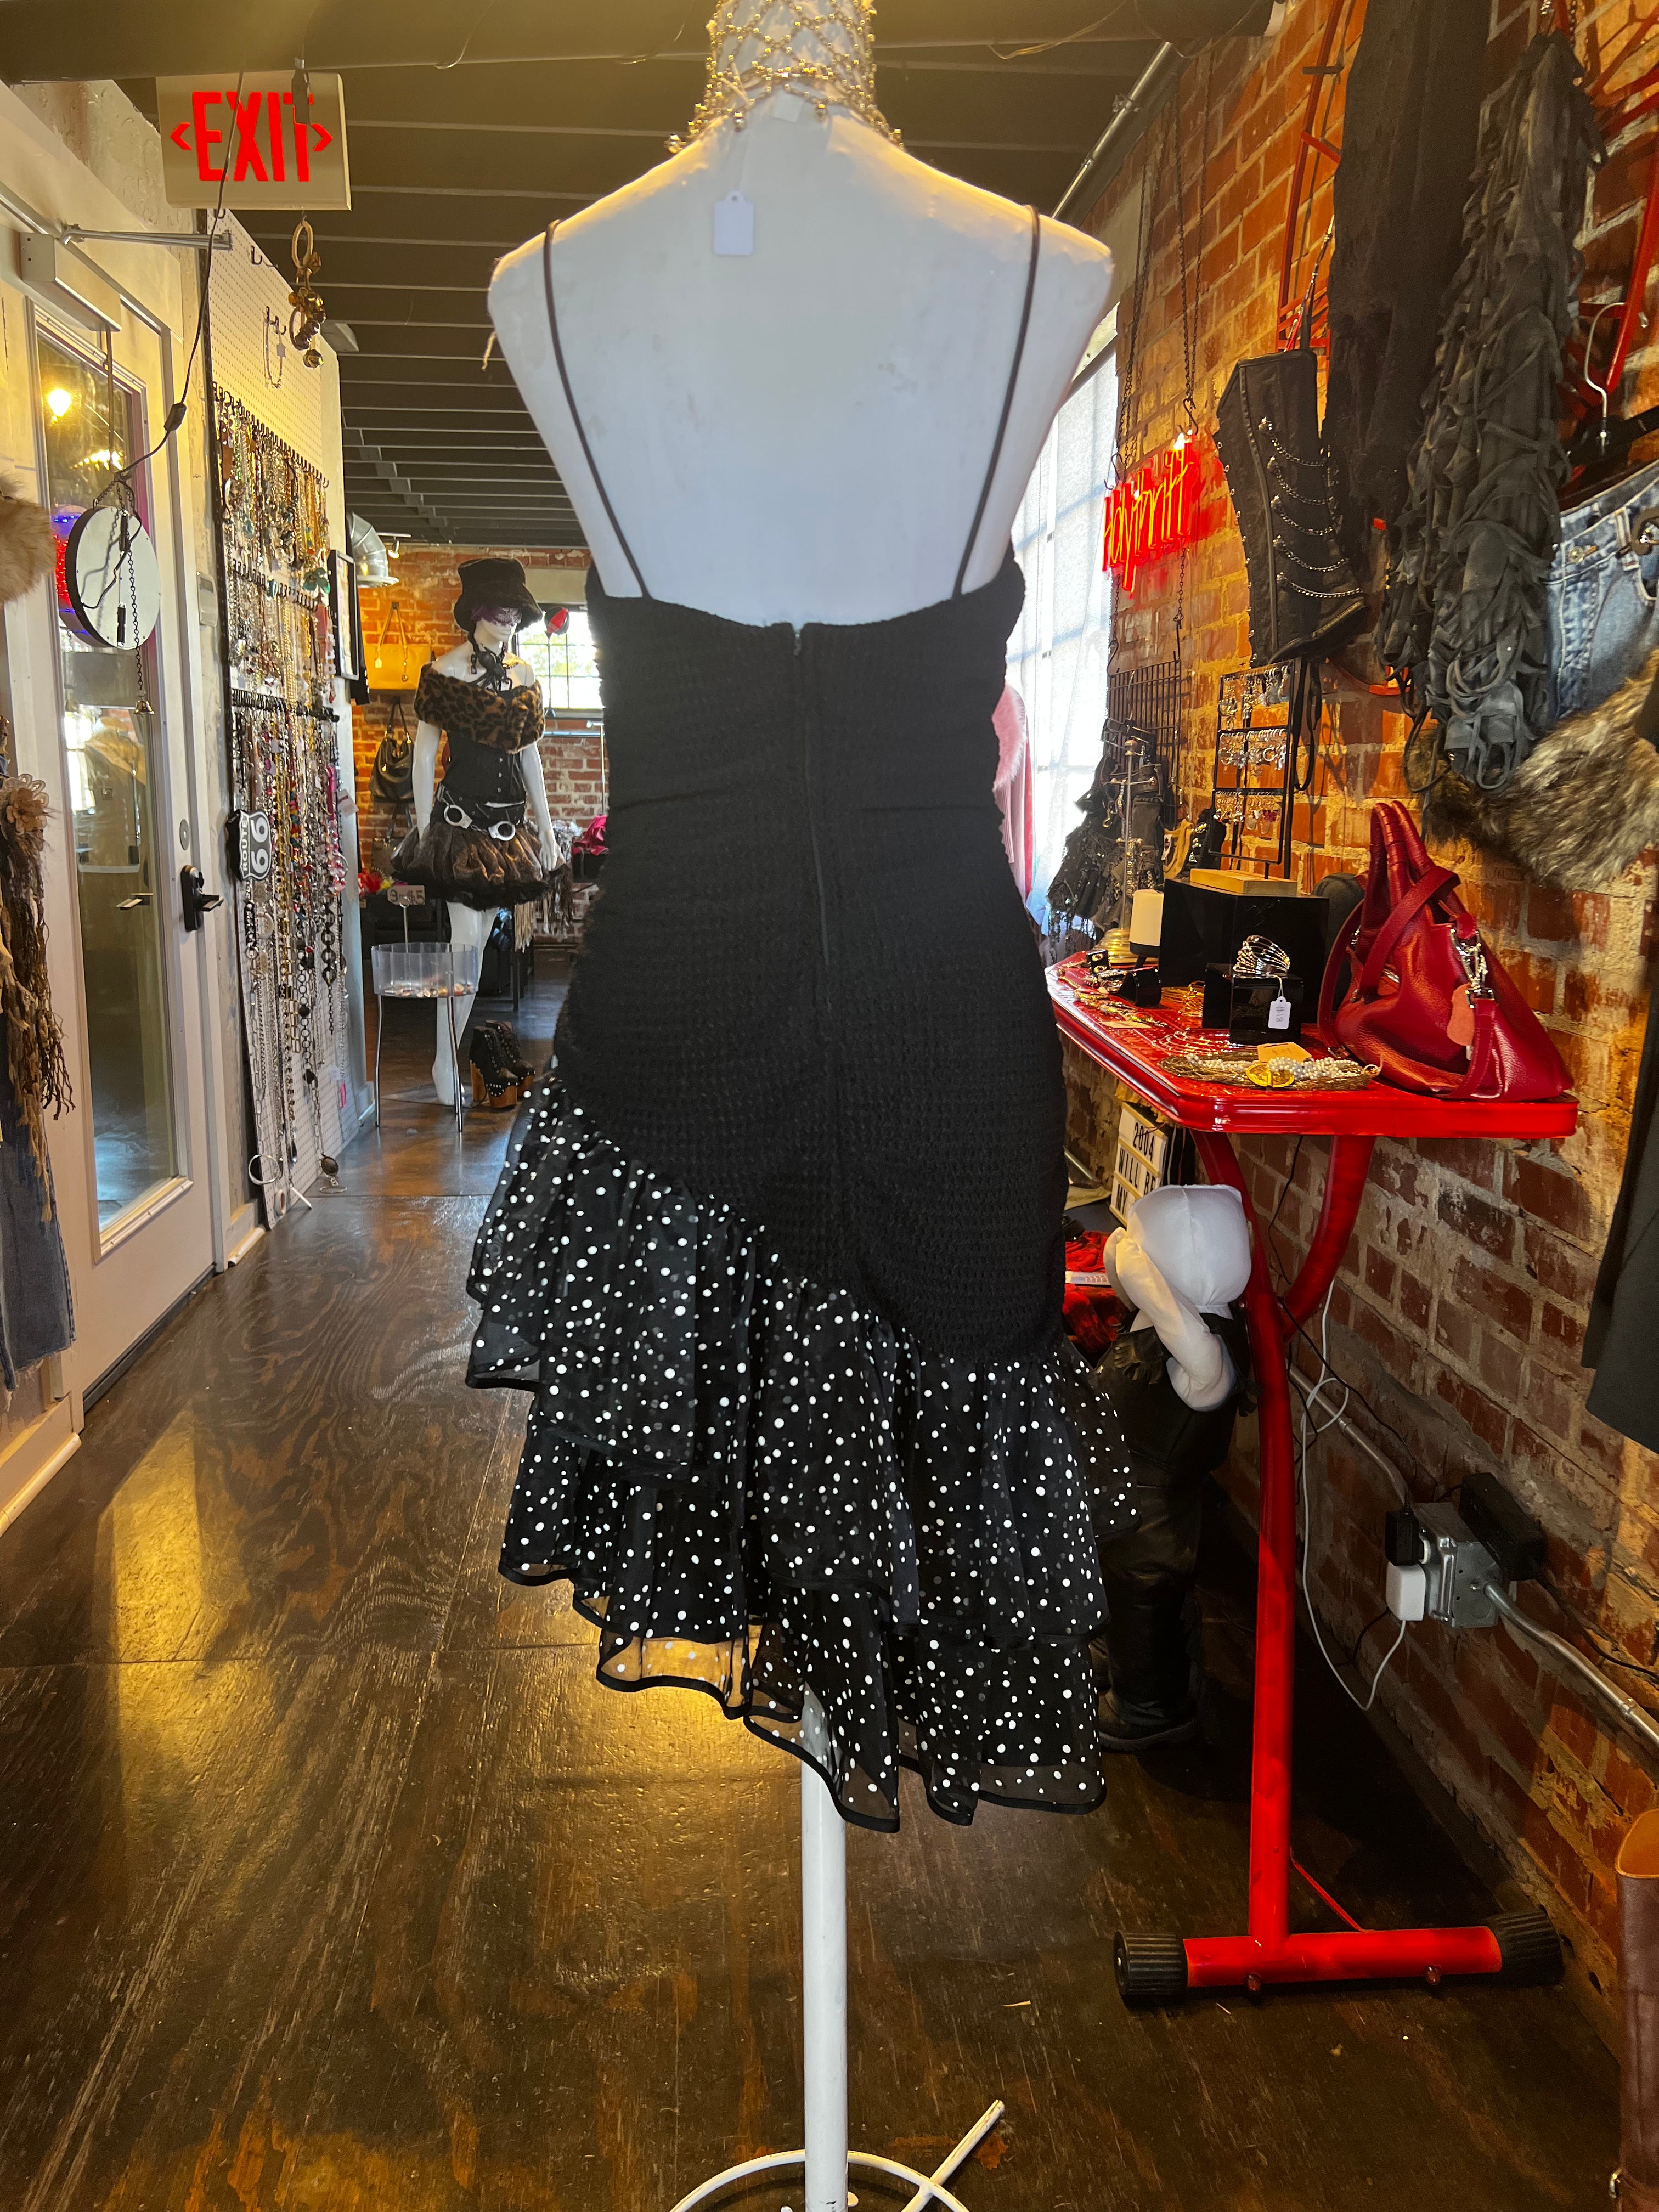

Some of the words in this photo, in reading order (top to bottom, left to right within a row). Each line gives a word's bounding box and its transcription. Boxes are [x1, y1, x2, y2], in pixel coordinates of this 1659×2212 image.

[193, 91, 313, 182] EXIT
[251, 817, 268, 874] 66
[390, 889, 398, 902] 3
[1133, 1122, 1154, 1161] 2004
[1119, 1148, 1138, 1189] WILL
[1115, 1184, 1128, 1215] MY
